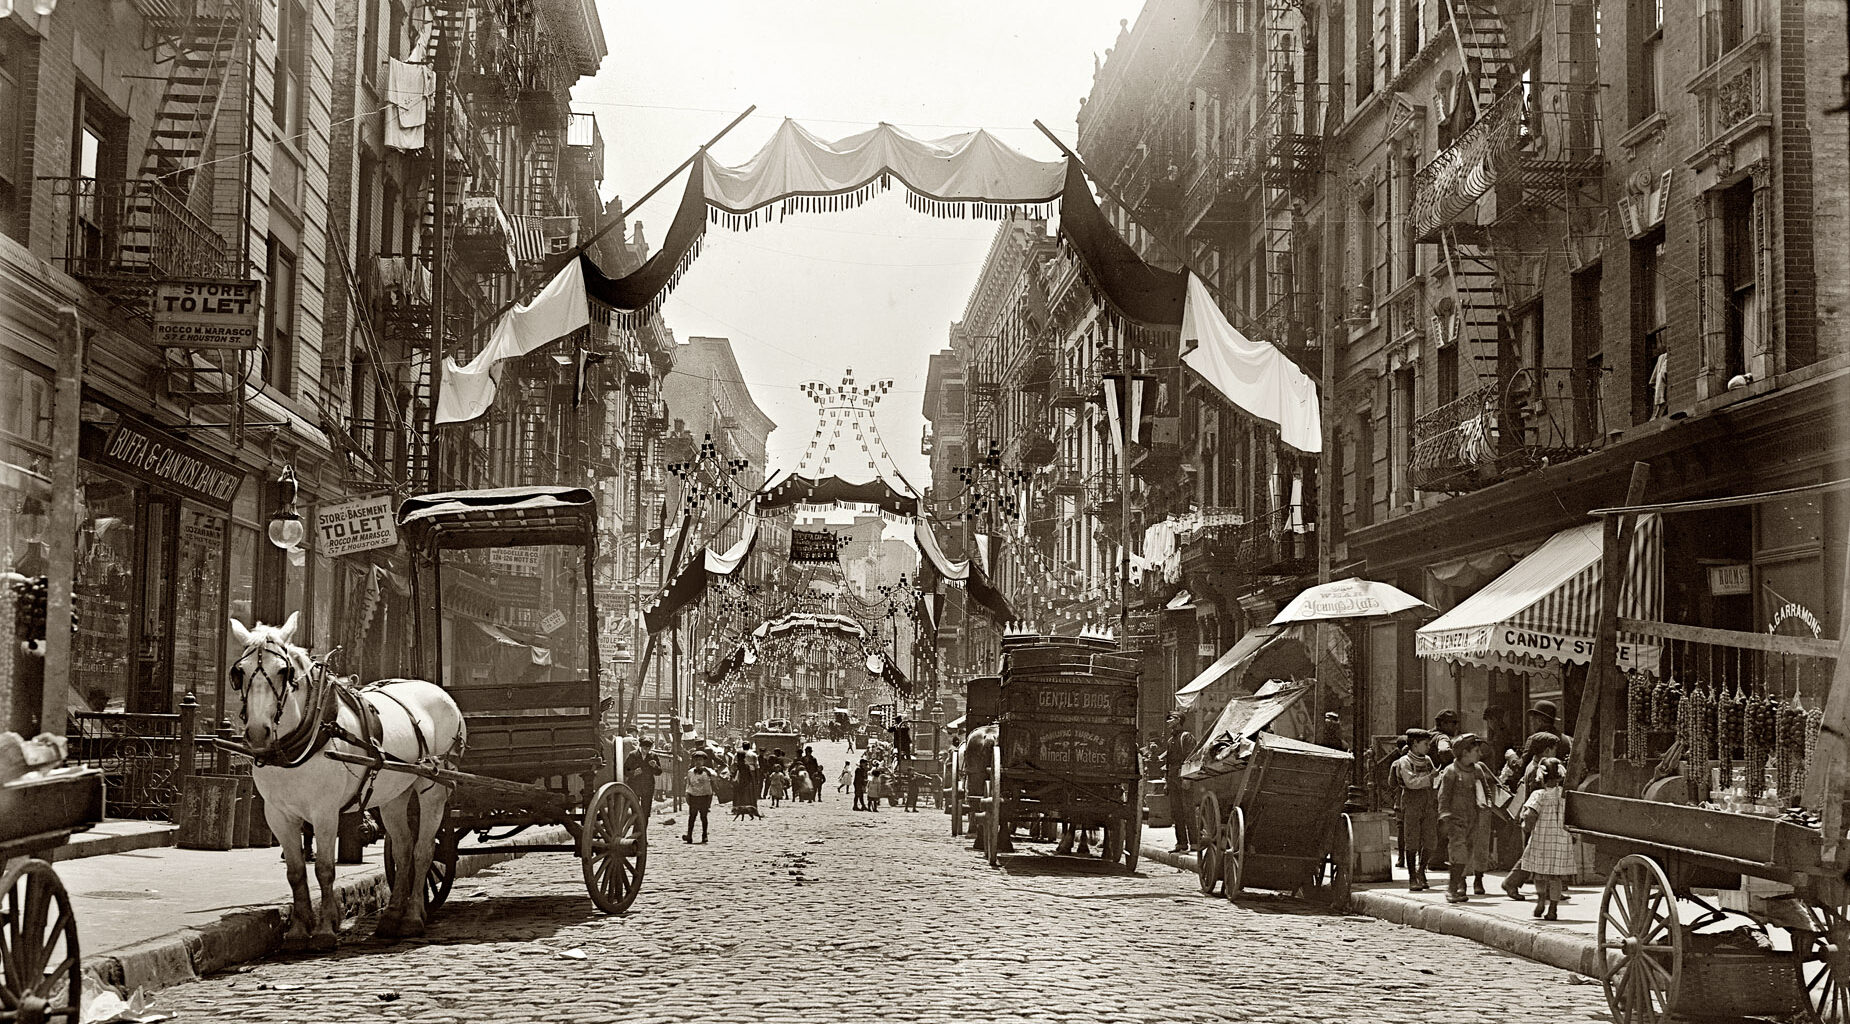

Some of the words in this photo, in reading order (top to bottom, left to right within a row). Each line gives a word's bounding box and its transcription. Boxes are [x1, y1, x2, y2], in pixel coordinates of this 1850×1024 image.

[163, 296, 197, 313] TO
[202, 297, 252, 315] LET
[158, 325, 192, 334] ROCCO
[194, 327, 203, 335] M.
[204, 327, 252, 337] MARASCO
[109, 427, 149, 467] BUFFA
[144, 443, 161, 470] &
[194, 464, 241, 502] BANCHIERI
[347, 504, 387, 520] BASEMENT
[321, 523, 346, 540] TO
[348, 515, 385, 535] LET
[329, 536, 351, 548] ROCCO
[359, 529, 391, 542] MARASCO.
[1719, 567, 1745, 586] ROOMS
[542, 613, 561, 625] STORE
[1774, 603, 1822, 640] GARRAMONE
[1505, 630, 1565, 651] CANDY
[1573, 640, 1631, 661] STE
[1040, 691, 1080, 709] GENTILE
[1040, 742, 1071, 763] Mineral
[1075, 748, 1107, 764] Waters
